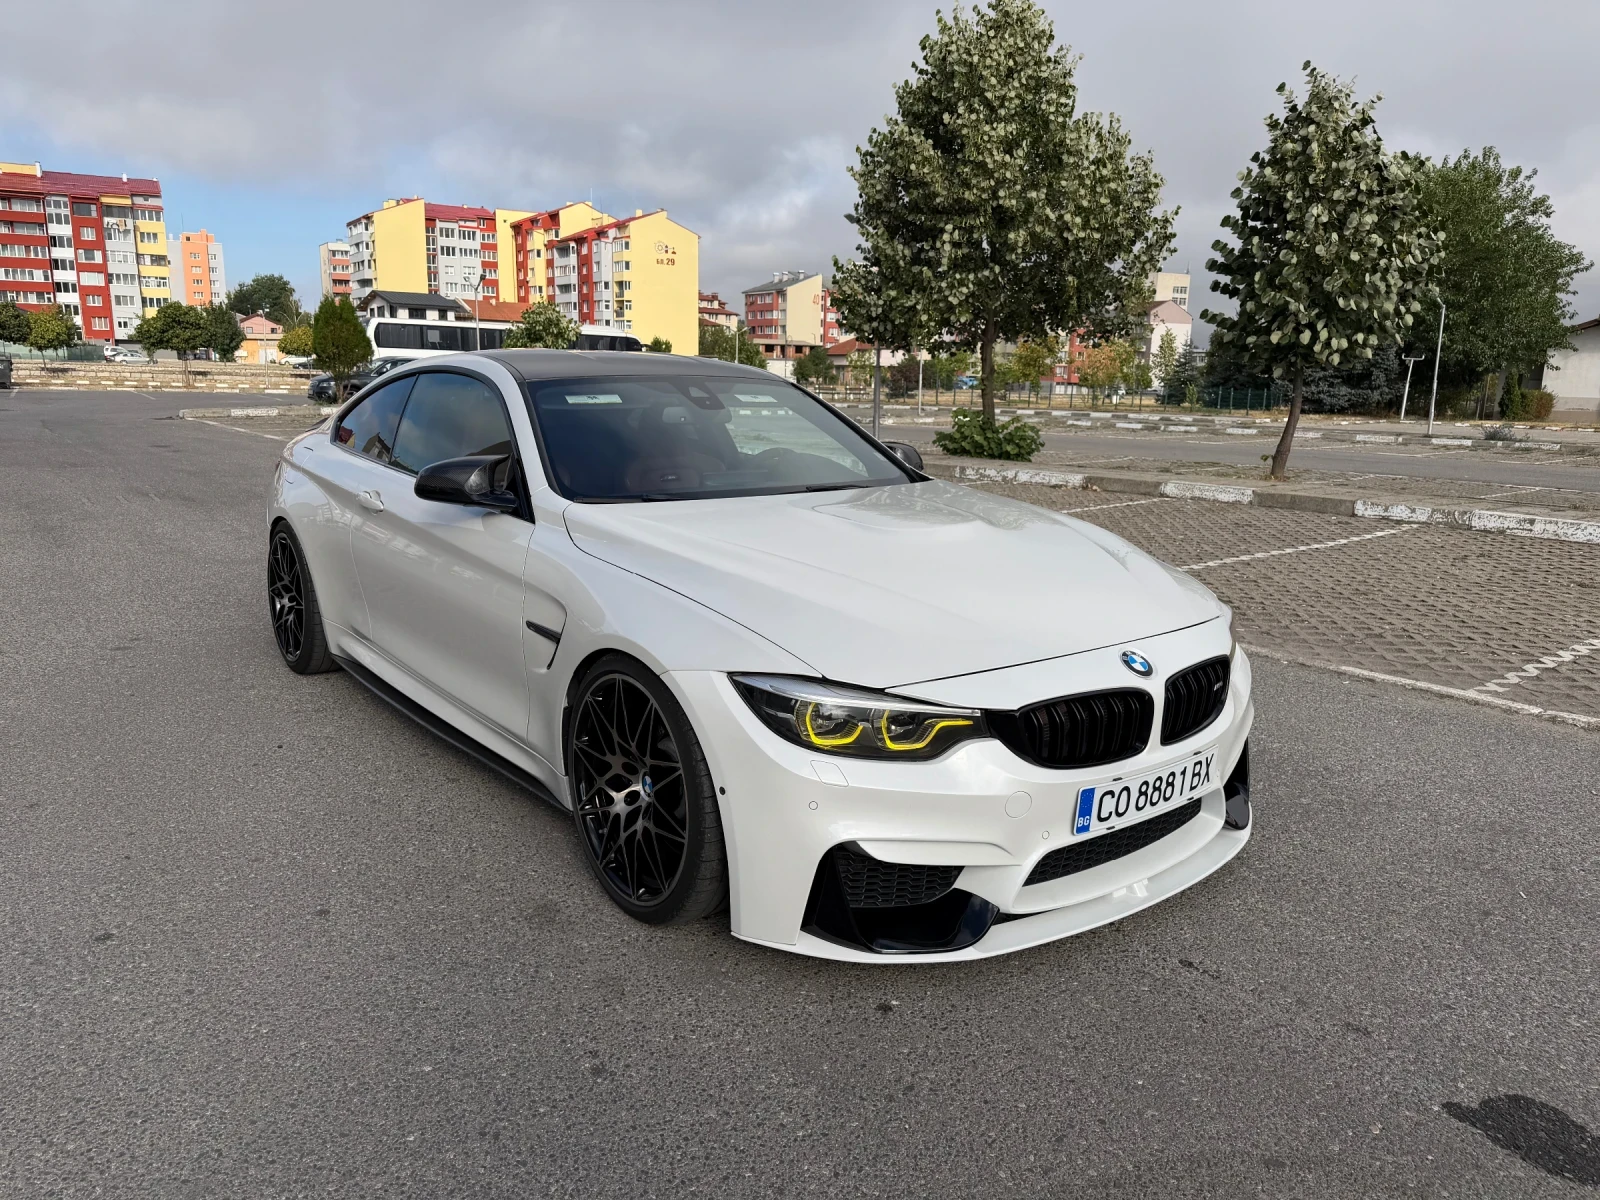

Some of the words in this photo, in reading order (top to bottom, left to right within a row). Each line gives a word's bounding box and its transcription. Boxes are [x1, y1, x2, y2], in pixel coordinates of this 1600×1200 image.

[666, 258, 675, 266] 29
[812, 294, 819, 305] 40
[1077, 815, 1090, 828] BG
